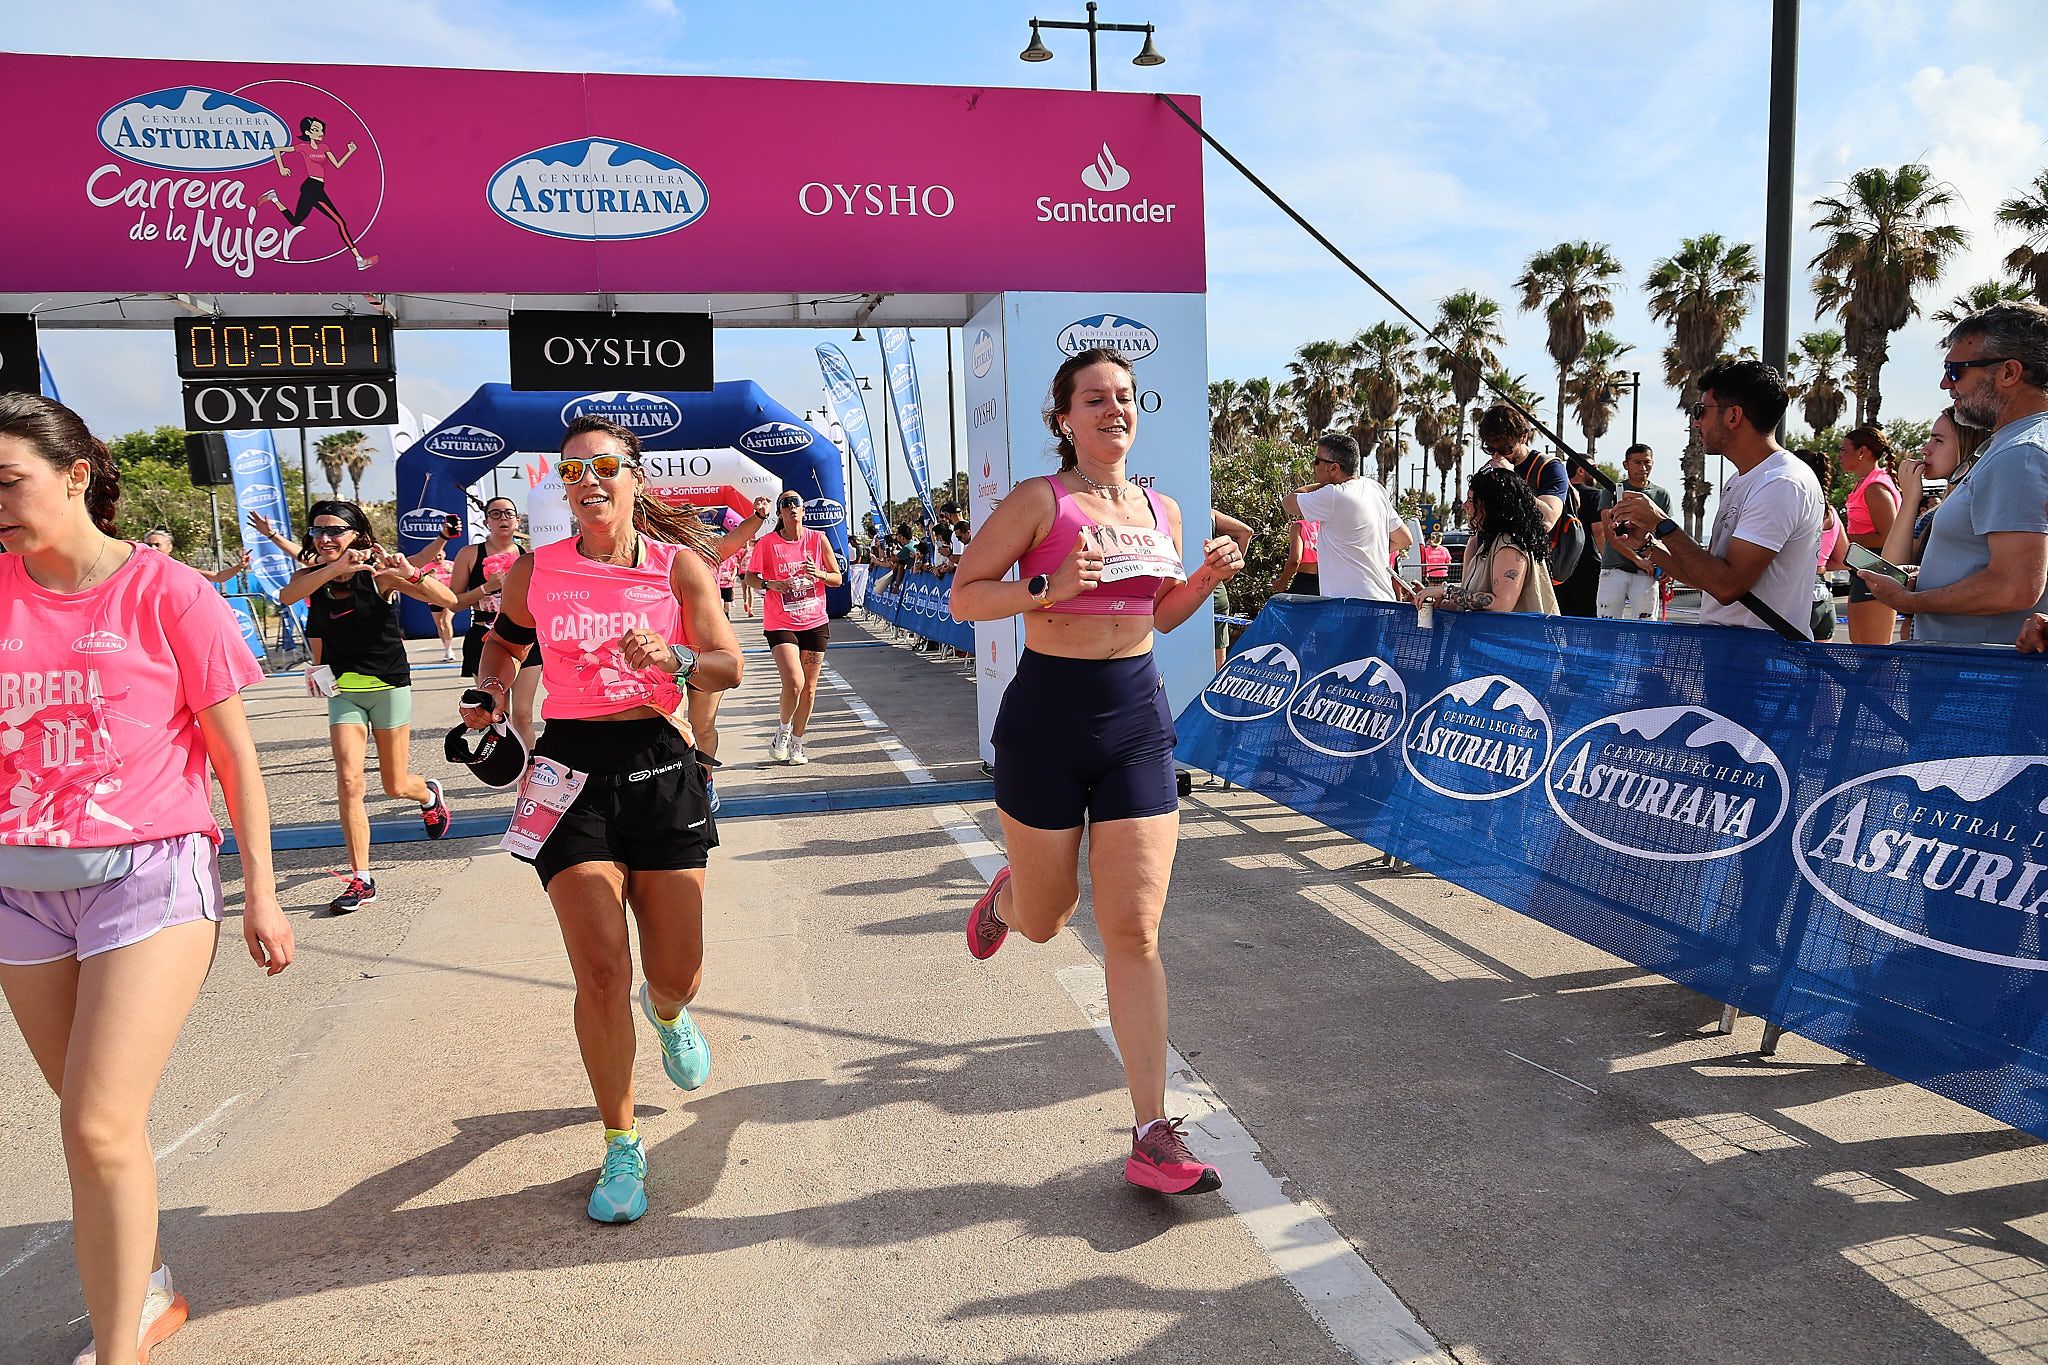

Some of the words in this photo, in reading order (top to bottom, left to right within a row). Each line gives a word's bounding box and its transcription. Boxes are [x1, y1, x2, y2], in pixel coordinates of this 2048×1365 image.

[114, 116, 276, 150] ASTURIANA
[142, 114, 206, 125] CENTRAL
[209, 116, 270, 126] LECHERA
[86, 163, 246, 210] Carrera
[506, 174, 694, 214] ASTURIANA
[539, 173, 608, 183] CENTRAL
[615, 174, 684, 185] LECHERA
[798, 181, 956, 218] OYSHO
[1035, 195, 1177, 224] Santander
[129, 210, 159, 241] de
[164, 210, 188, 242] la
[184, 206, 307, 278] Mujer
[543, 336, 686, 368] OYSHO
[194, 382, 388, 424] OYSHO
[429, 437, 499, 452] ASTURIANA
[746, 435, 810, 448] ASTURIANA
[646, 456, 711, 478] SHO
[672, 486, 720, 496] Santander
[401, 519, 443, 532] ASTURIA
[532, 524, 563, 533] OYSHO
[778, 561, 803, 573] CARRE
[1110, 563, 1144, 575] OYSHO
[546, 590, 590, 602] OYSHO
[76, 640, 122, 649] ASTURIANA
[0, 668, 106, 709] RRERA
[1206, 665, 1286, 708] ASTURIANA
[1233, 665, 1262, 677] CENTRAL
[1262, 669, 1293, 684] LECHERA
[1292, 683, 1395, 741] ASTURIANA
[1326, 684, 1358, 701] CENTRAL
[1361, 690, 1398, 710] LECHERA
[1443, 710, 1486, 730] CENTRAL
[1488, 718, 1540, 740] LECHERA
[1408, 709, 1534, 780] ASTURIANA
[1603, 742, 1674, 772] CENTRAL
[1679, 757, 1766, 789] LECHERA
[1554, 741, 1757, 839] ASTURIANA
[1892, 803, 2017, 842] CENTRAL
[1808, 797, 2048, 918] ASTURI
